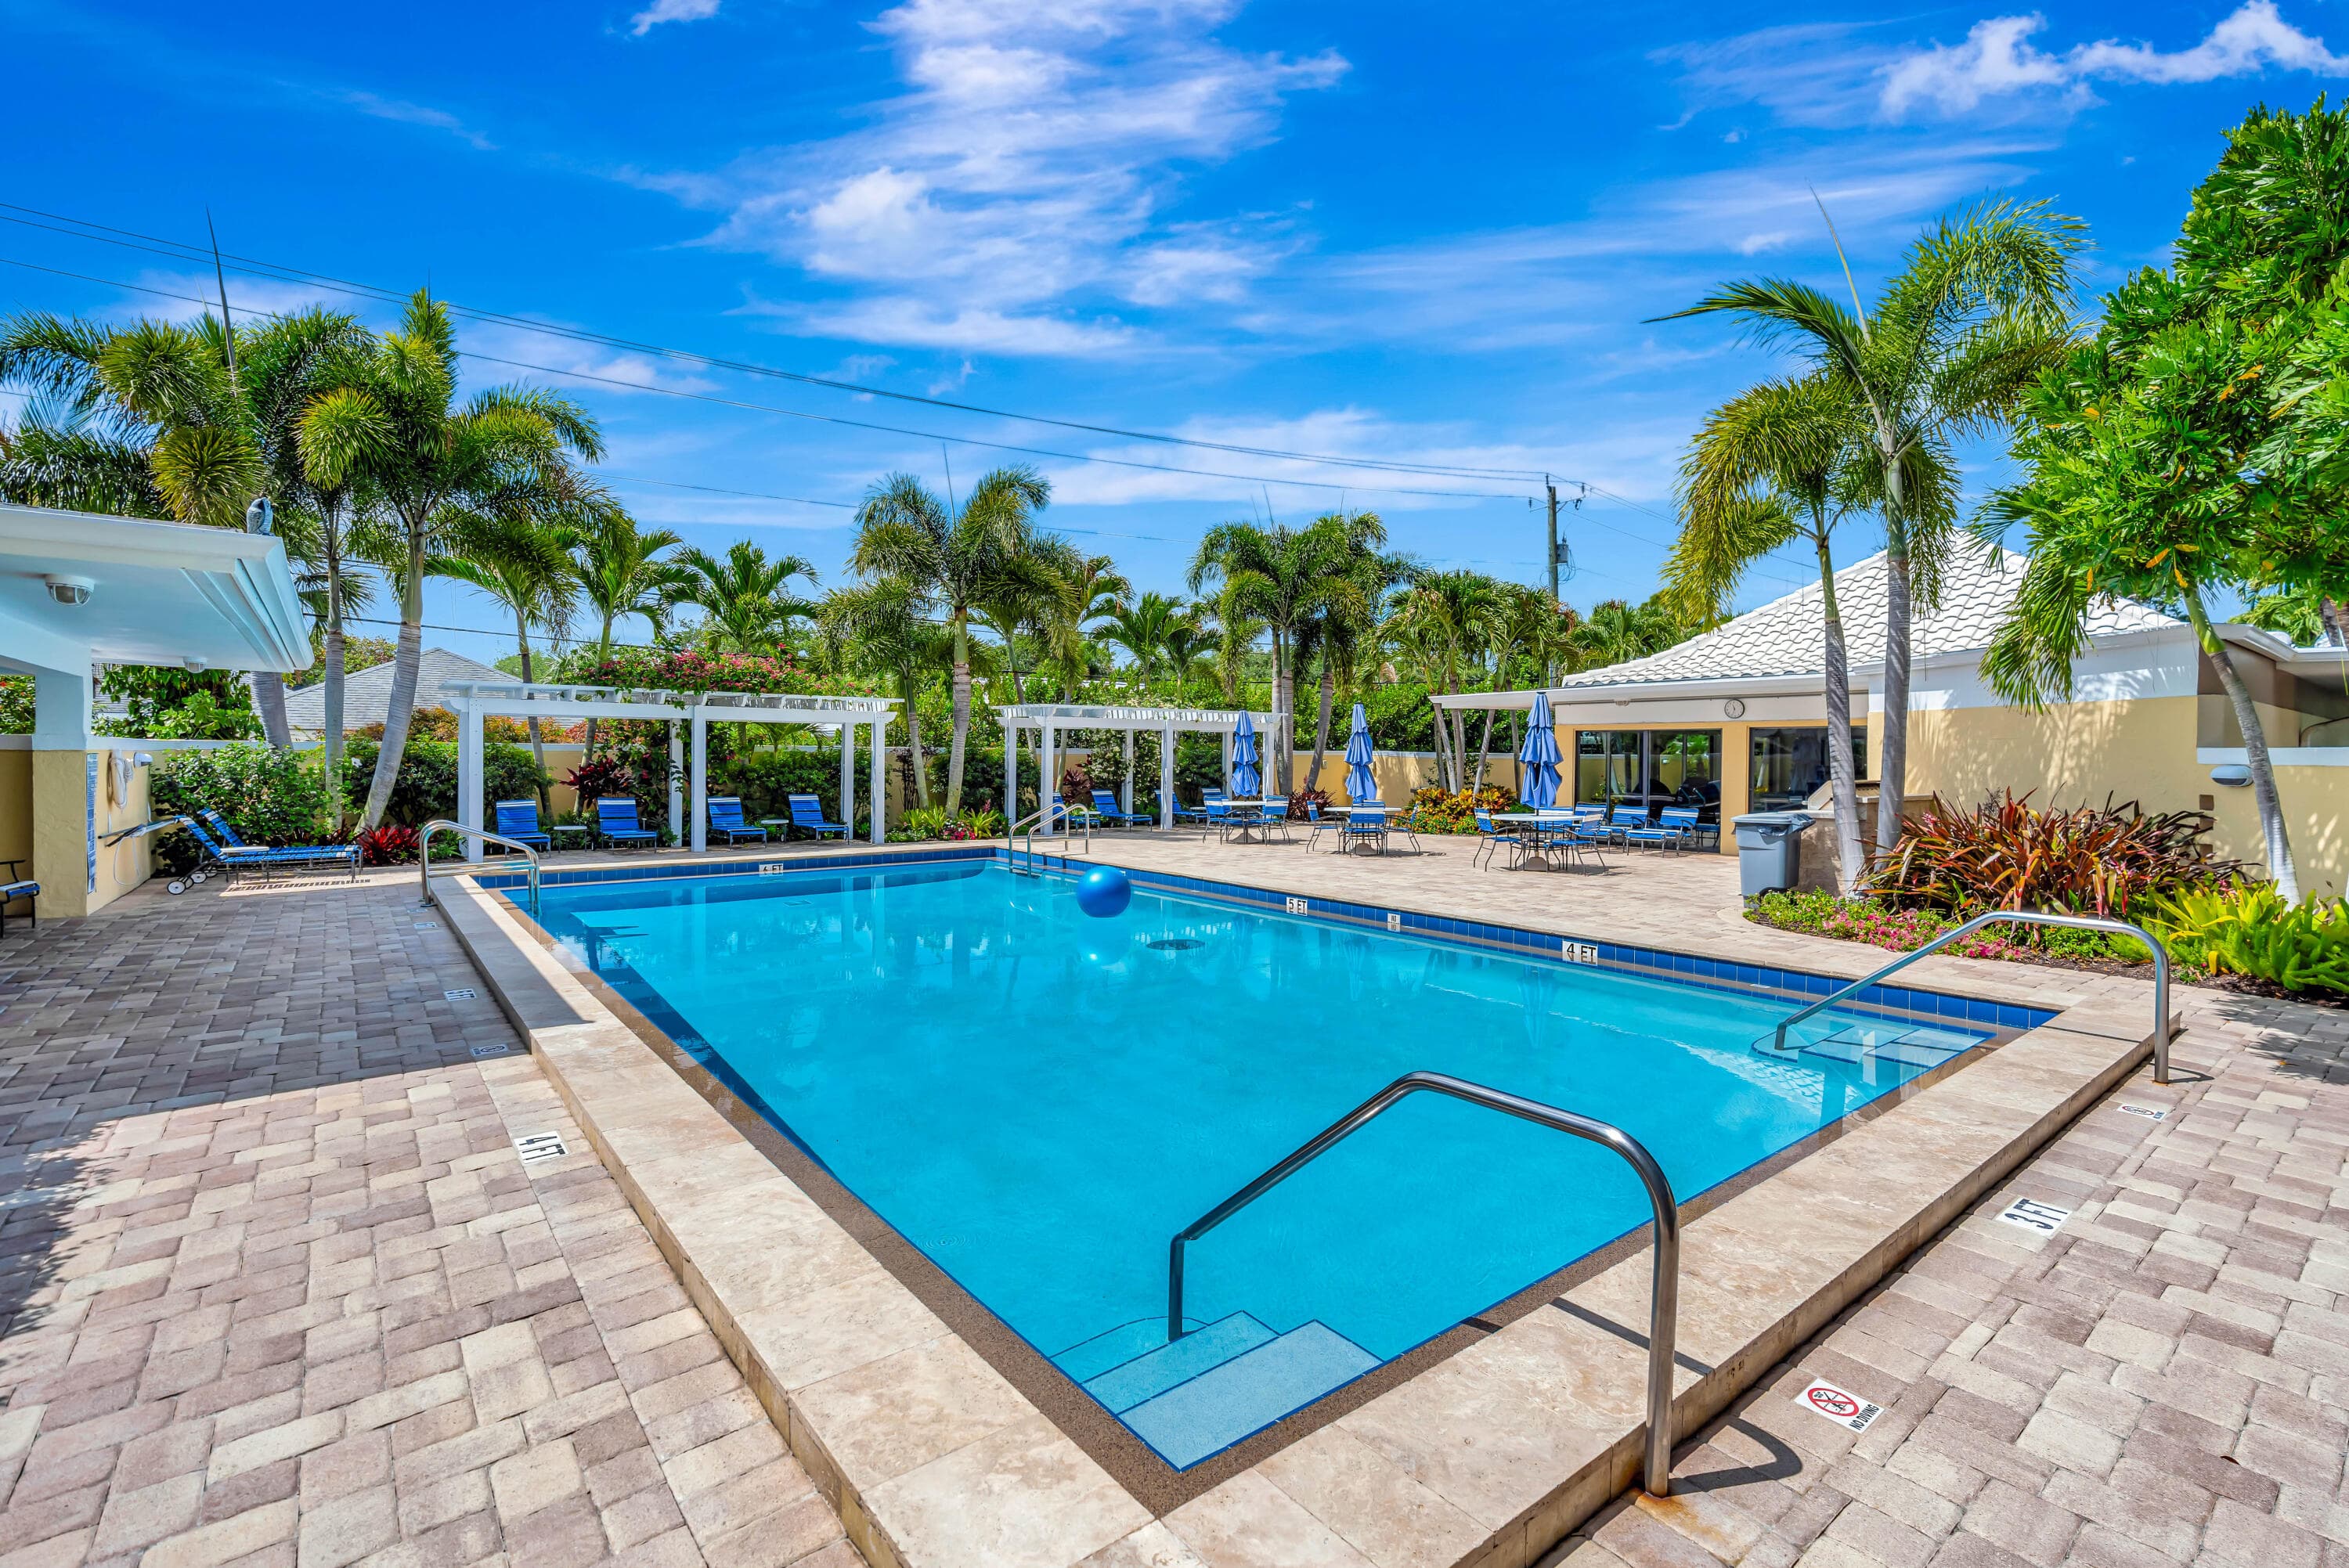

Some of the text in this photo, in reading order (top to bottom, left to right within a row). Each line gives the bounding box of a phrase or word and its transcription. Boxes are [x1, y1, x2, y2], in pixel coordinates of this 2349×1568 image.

[518, 1136, 565, 1160] 4 FT
[2004, 1199, 2067, 1230] 3 FT
[1849, 1404, 1879, 1430] NO DIVING
